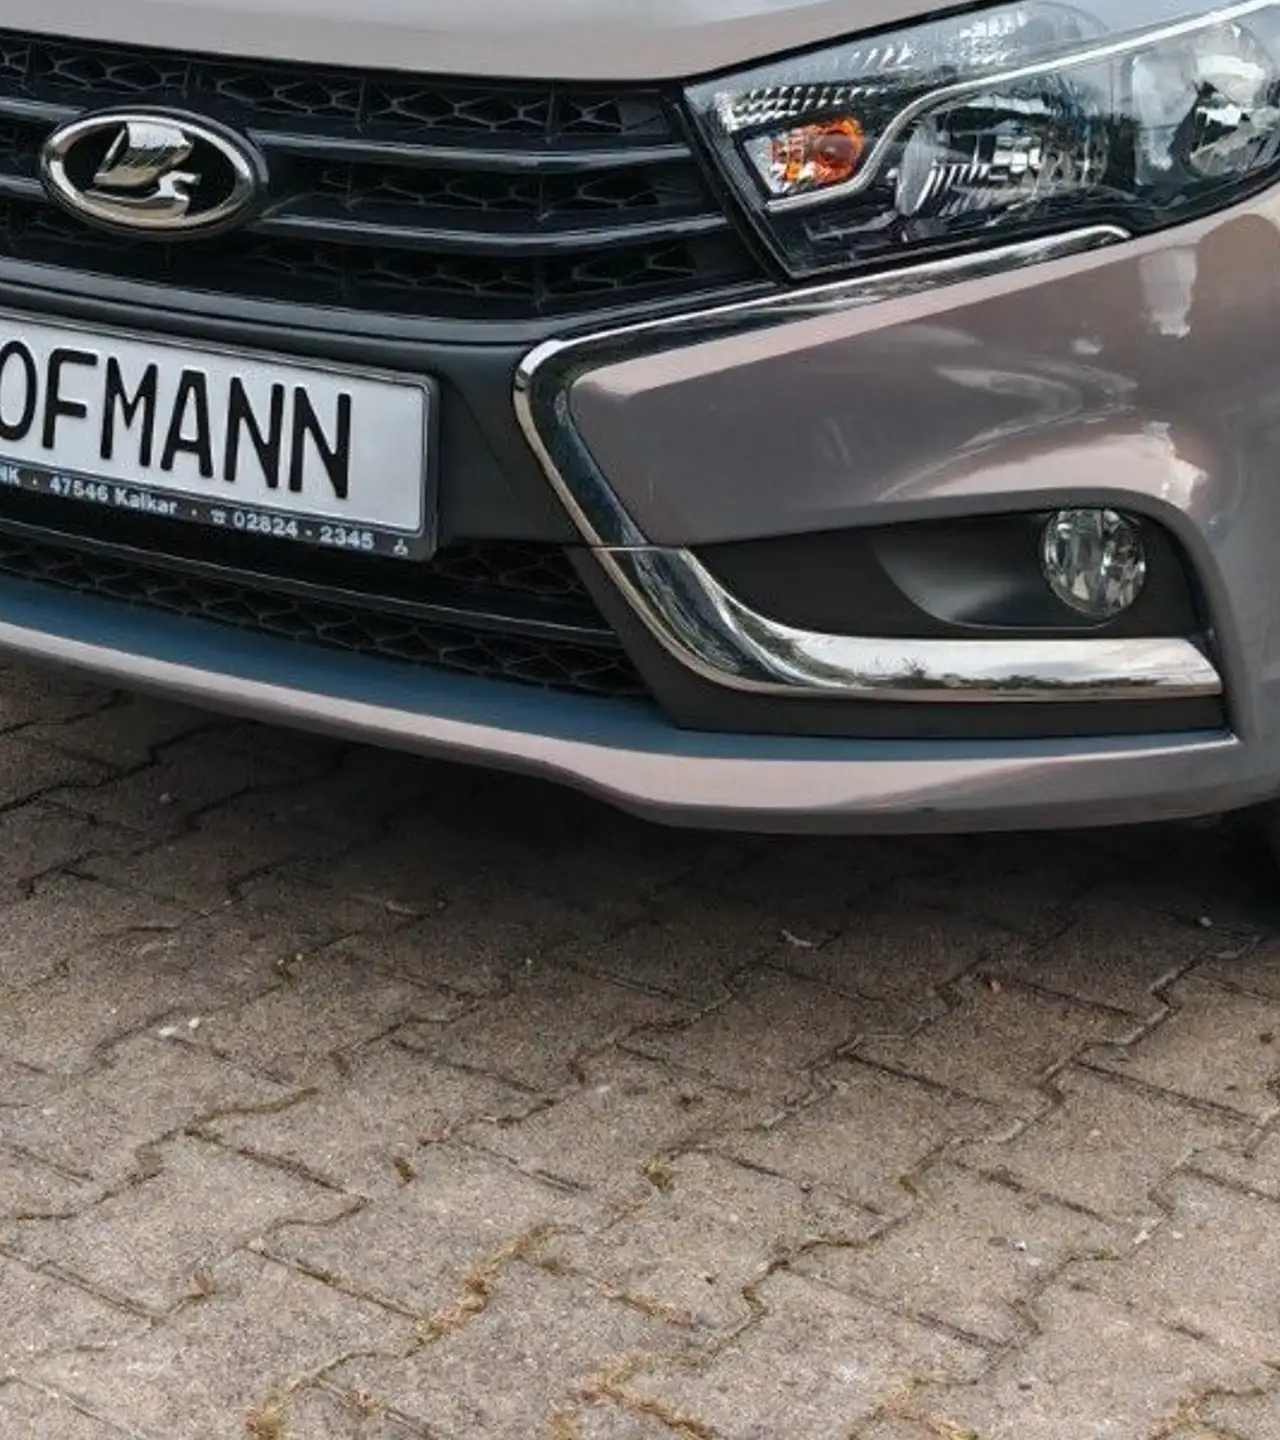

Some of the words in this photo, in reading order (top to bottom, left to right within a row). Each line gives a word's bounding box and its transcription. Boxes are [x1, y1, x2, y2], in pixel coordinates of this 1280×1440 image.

[114, 487, 178, 515] Kalkar
[232, 511, 299, 539] 02824
[319, 525, 375, 551] 2345
